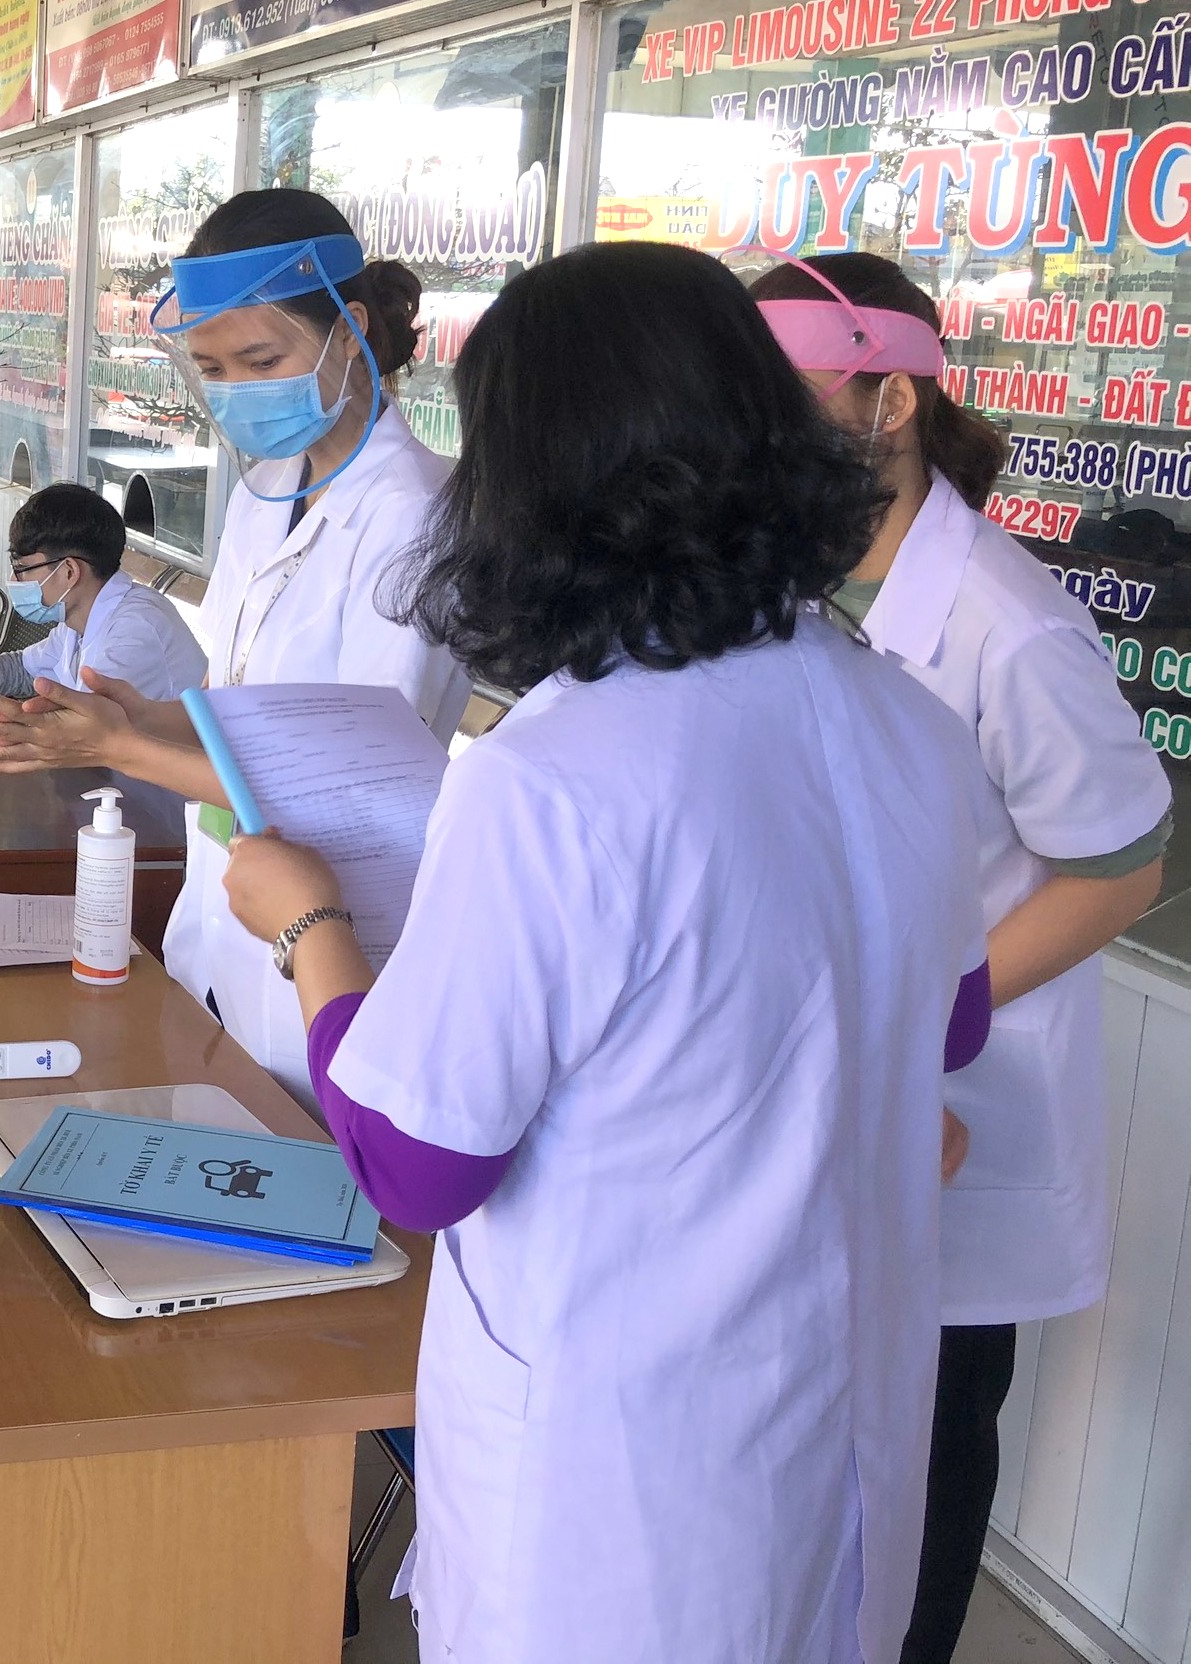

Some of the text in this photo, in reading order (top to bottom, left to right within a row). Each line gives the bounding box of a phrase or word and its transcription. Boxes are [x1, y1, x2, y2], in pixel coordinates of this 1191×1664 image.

[219, 3, 284, 40] 0913.612.952
[640, 33, 676, 85] XE
[683, 26, 725, 78] VIP
[731, 1, 900, 70] LIMOUSINE
[909, 0, 956, 40] 22
[756, 70, 883, 132] GIƯỜNG
[894, 45, 990, 120] NẰM
[1002, 42, 1095, 109] CAO
[702, 109, 1191, 256] DUY TÙNG
[1002, 292, 1079, 345] NGÃI
[1086, 301, 1165, 349] GIAO
[974, 362, 1069, 416] THÀNH
[1101, 369, 1170, 427] ĐẤT
[1008, 434, 1119, 488] 755.388
[985, 495, 1080, 542] 42297
[144, 1135, 164, 1146] TẾ
[119, 1180, 140, 1194] TỜ
[128, 1156, 154, 1180] KHAI
